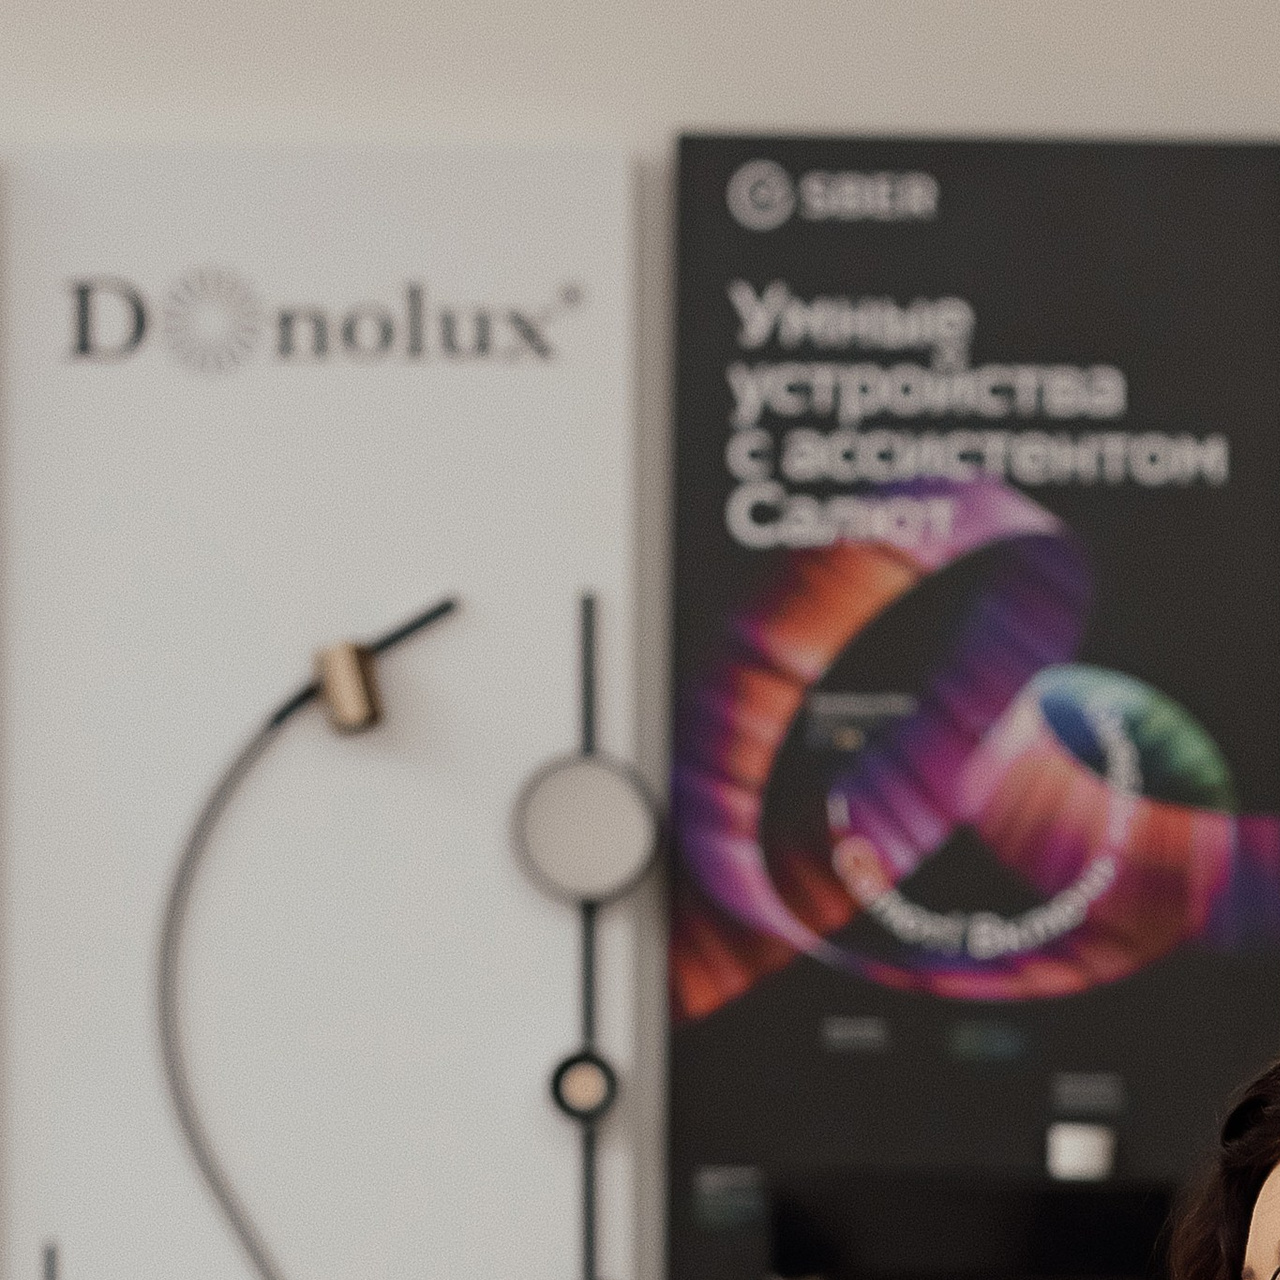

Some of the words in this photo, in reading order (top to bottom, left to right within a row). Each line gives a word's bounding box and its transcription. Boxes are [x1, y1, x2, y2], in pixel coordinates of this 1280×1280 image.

[728, 279, 974, 349] Умные
[728, 354, 1127, 428] устройства
[727, 428, 775, 483] с
[782, 430, 1230, 486] ассистентом
[727, 478, 954, 548] Салют
